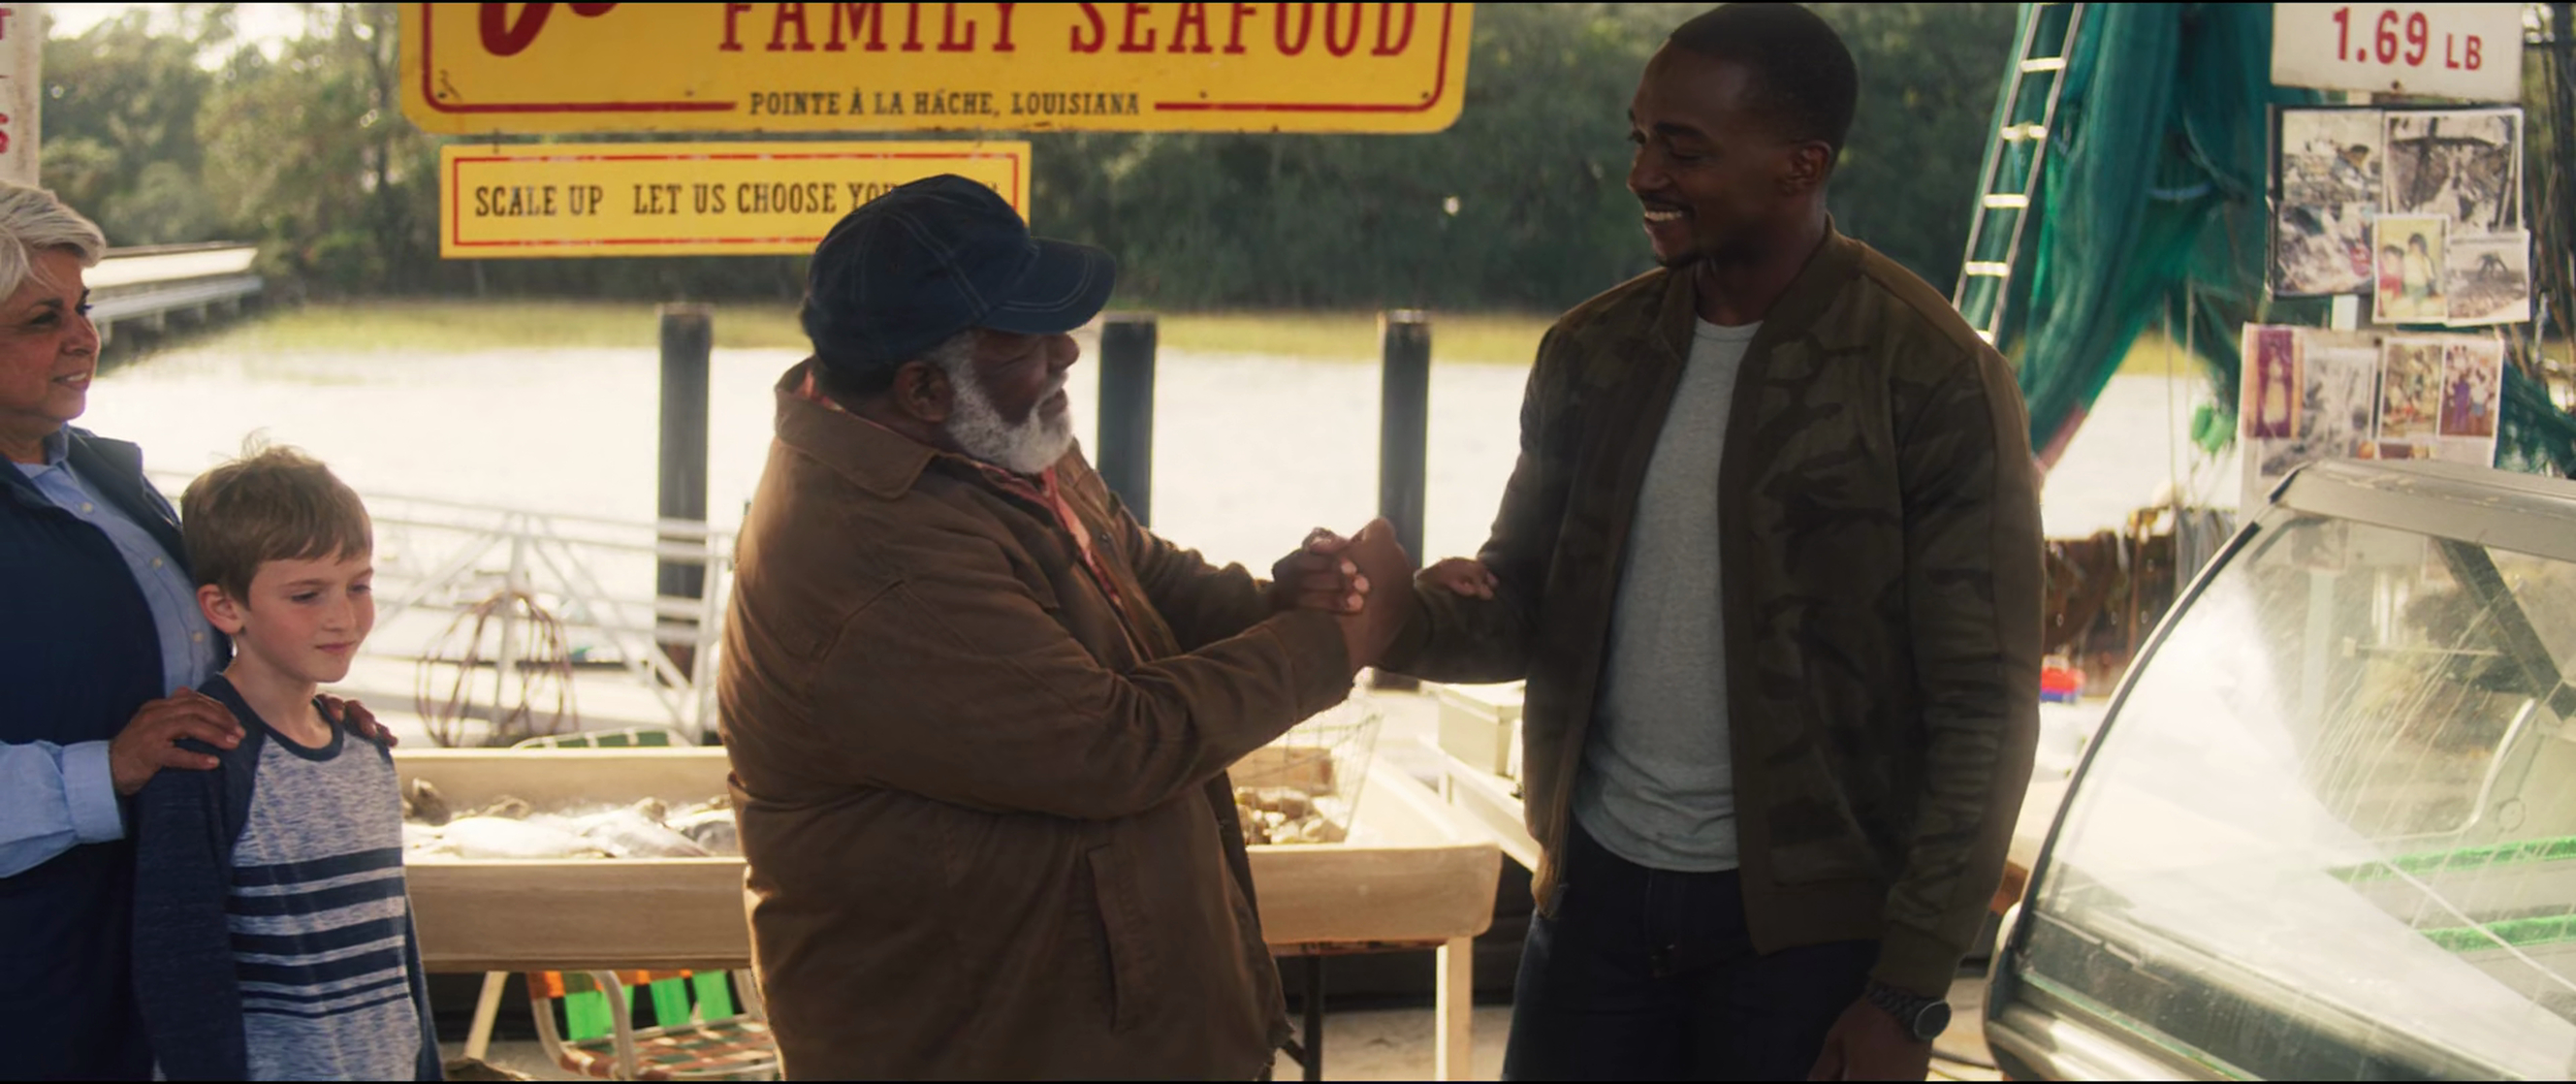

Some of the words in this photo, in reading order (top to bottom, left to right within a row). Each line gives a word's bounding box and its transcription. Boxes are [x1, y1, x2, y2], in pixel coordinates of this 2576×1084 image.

[2333, 7, 2429, 66] 1.69
[2445, 33, 2482, 70] LB
[749, 92, 841, 115] POINTE
[875, 92, 904, 115] LA
[1011, 92, 1139, 115] LOUISIANA
[475, 185, 557, 216] SCALE
[569, 185, 603, 215] UP
[633, 184, 682, 214] LET
[693, 183, 726, 213] US
[737, 182, 837, 213] CHOOSE
